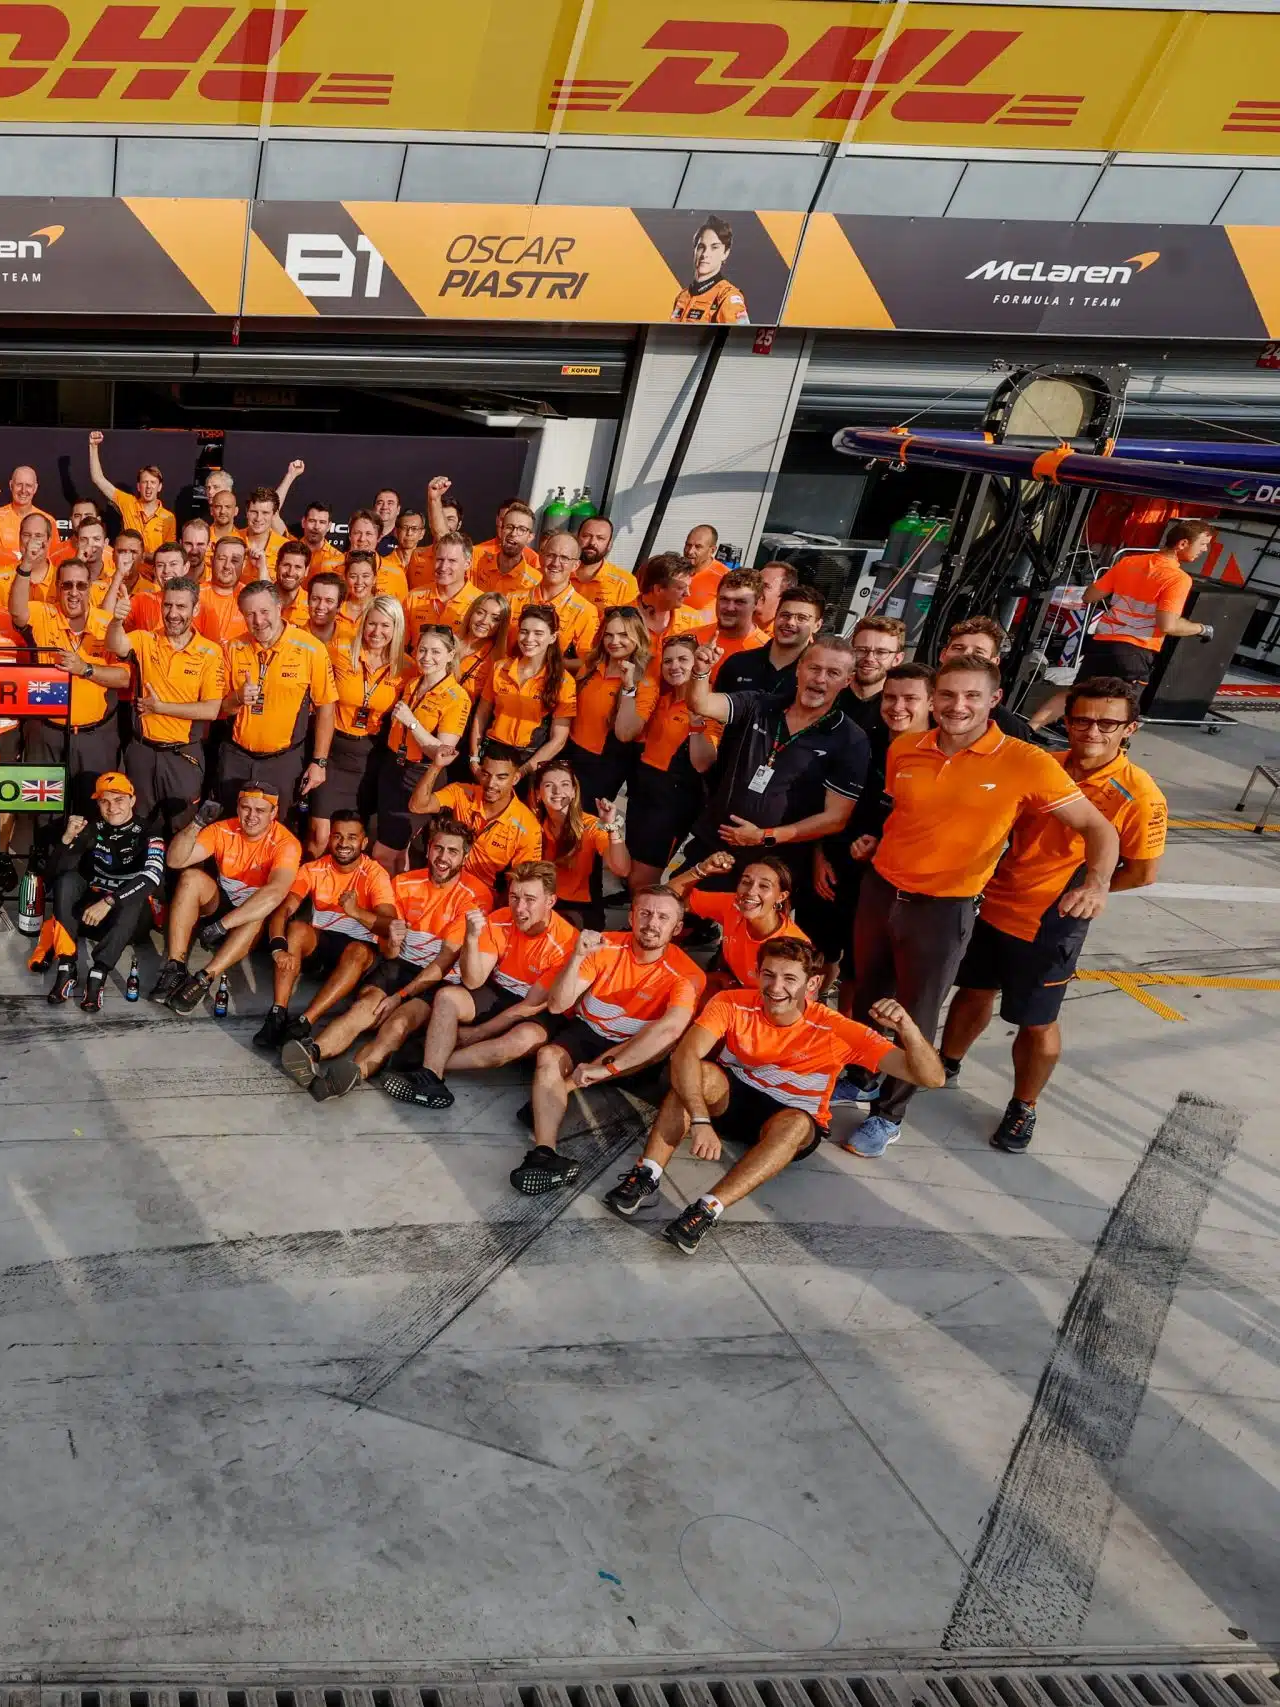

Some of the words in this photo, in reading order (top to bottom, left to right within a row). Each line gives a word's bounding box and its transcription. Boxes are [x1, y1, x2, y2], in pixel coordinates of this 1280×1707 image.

[617, 18, 1024, 126] DHL
[445, 234, 577, 266] OSCAR
[2, 272, 42, 283] TEAM
[284, 233, 384, 298] 81
[965, 259, 1133, 285] McLaren
[437, 270, 590, 301] PIASTRI
[992, 294, 1061, 307] FORMULA
[1068, 297, 1075, 307] 1
[1082, 297, 1122, 308] TEAM
[754, 329, 776, 348] 25
[570, 367, 598, 375] KOPRON
